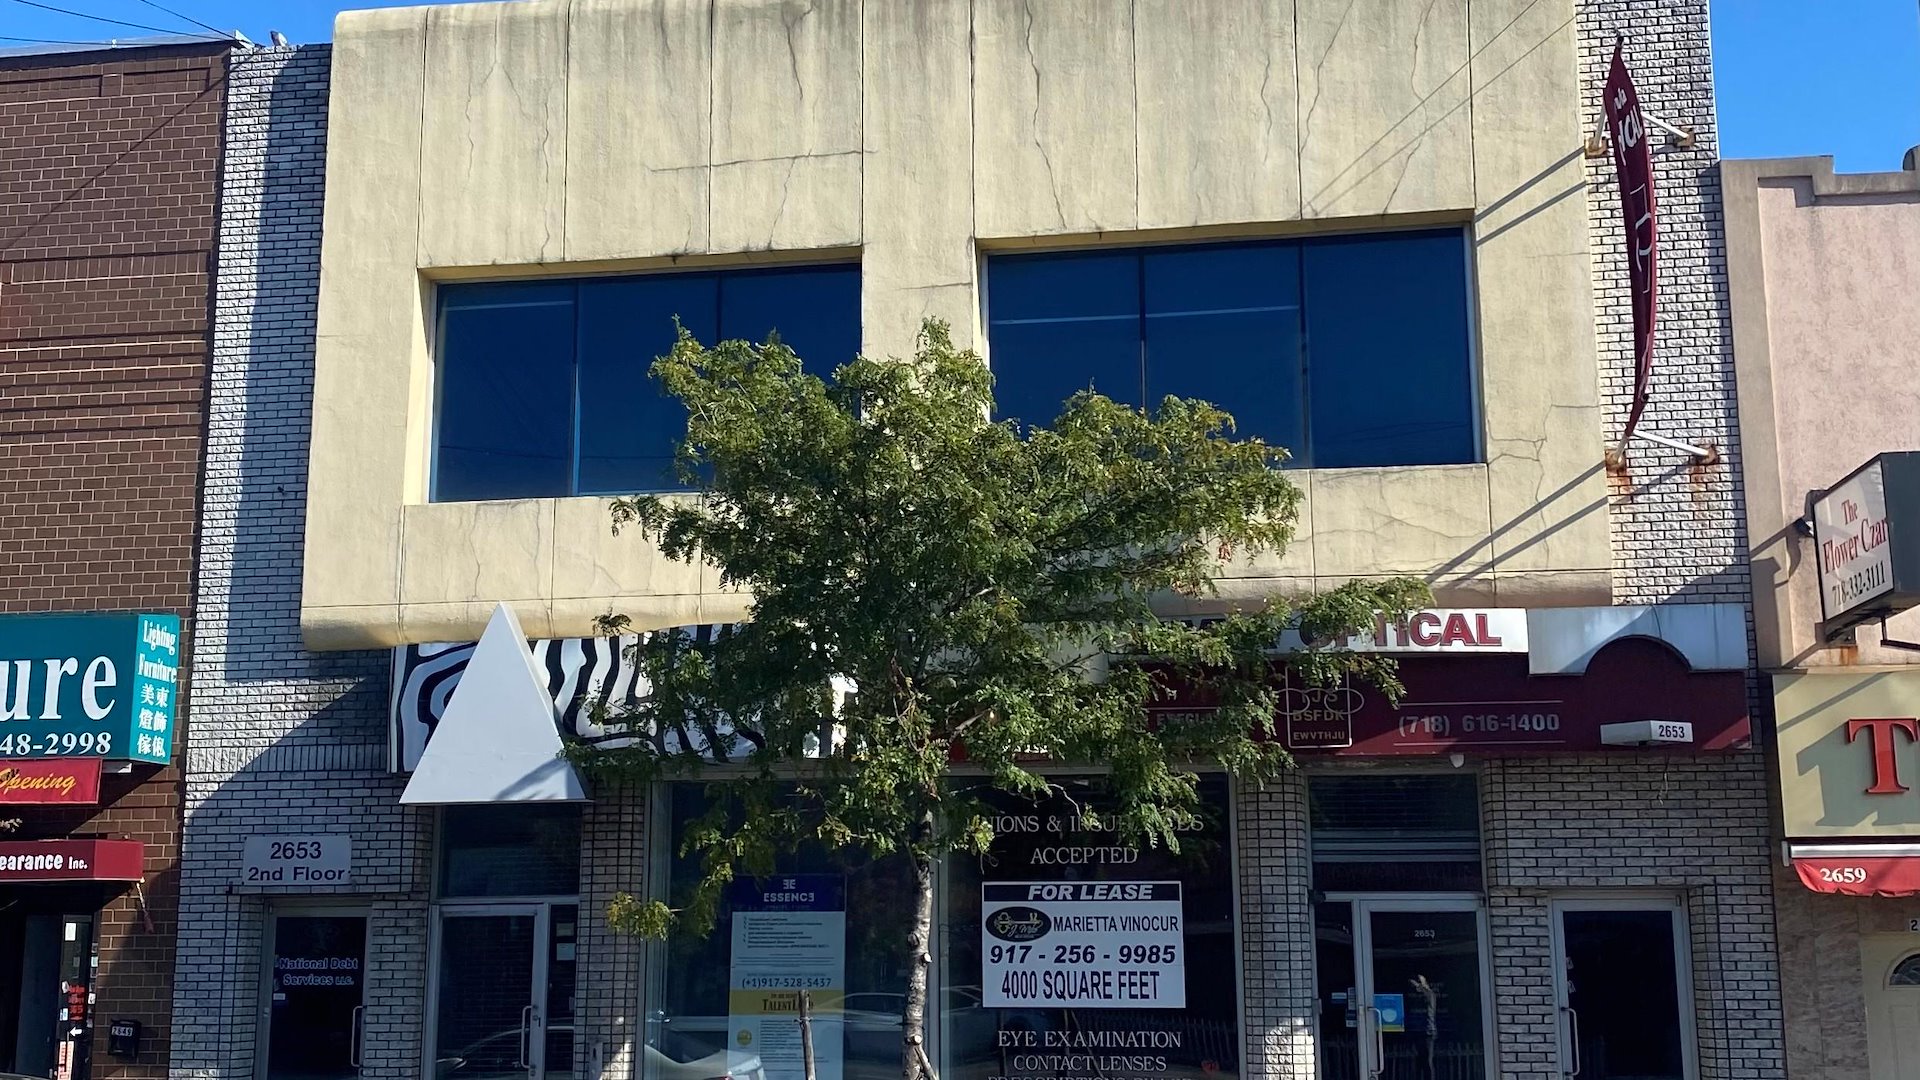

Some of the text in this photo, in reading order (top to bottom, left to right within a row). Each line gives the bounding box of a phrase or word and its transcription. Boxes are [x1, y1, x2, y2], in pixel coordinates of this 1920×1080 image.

[1841, 499, 1858, 525] The
[1823, 517, 1888, 574] Flower Czar
[1831, 560, 1886, 607] 718-332-3111
[143, 619, 176, 656] Lighting
[1300, 611, 1502, 648] OTICAL
[138, 652, 177, 684] Furniture
[1399, 713, 1560, 737] (718) 616-1400
[1658, 724, 1685, 739] 2653
[1293, 730, 1345, 740] EWVTHJU
[1046, 815, 1062, 832] &
[270, 841, 322, 861] 2653
[1030, 847, 1139, 865] ACCEPTED
[68, 856, 88, 870] Inc.
[247, 868, 345, 882] 2nd Floor
[1820, 867, 1867, 884] 2659
[1028, 885, 1153, 900] FOR LEASE
[1053, 916, 1118, 932] MARIETTA
[1120, 916, 1179, 932] VINOCUR
[1414, 930, 1435, 938] 2653
[280, 957, 358, 969] National Debt
[989, 945, 1032, 964] 917
[1053, 945, 1096, 964] 256
[1118, 945, 1176, 964] 9985
[283, 973, 333, 985] Services
[742, 978, 832, 989] (+1)917-528-5437
[1001, 970, 1160, 1001] 4000 SQUARE FEET
[998, 1030, 1182, 1048] EYE EXAMINATION
[1014, 1055, 1167, 1071] CONTACT LENSES
